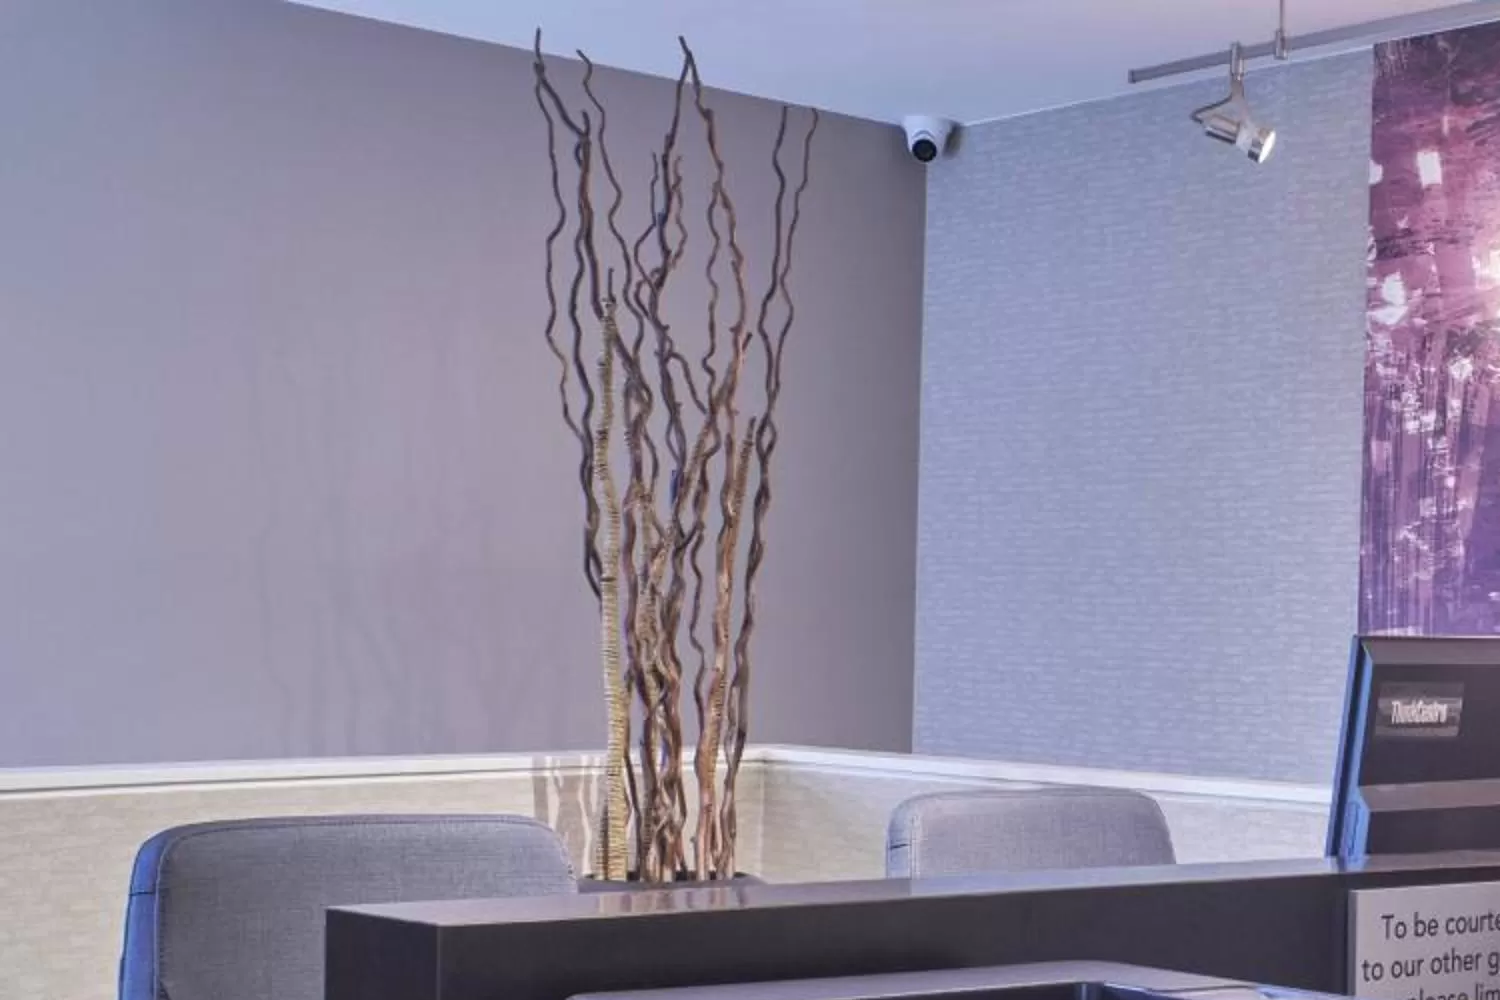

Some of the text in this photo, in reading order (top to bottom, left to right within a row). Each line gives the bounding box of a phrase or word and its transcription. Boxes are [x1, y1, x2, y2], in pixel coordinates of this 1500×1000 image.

[1381, 914, 1407, 940] To
[1413, 912, 1439, 937] be
[1361, 958, 1384, 982] to
[1391, 958, 1424, 979] our
[1430, 948, 1482, 975] other
